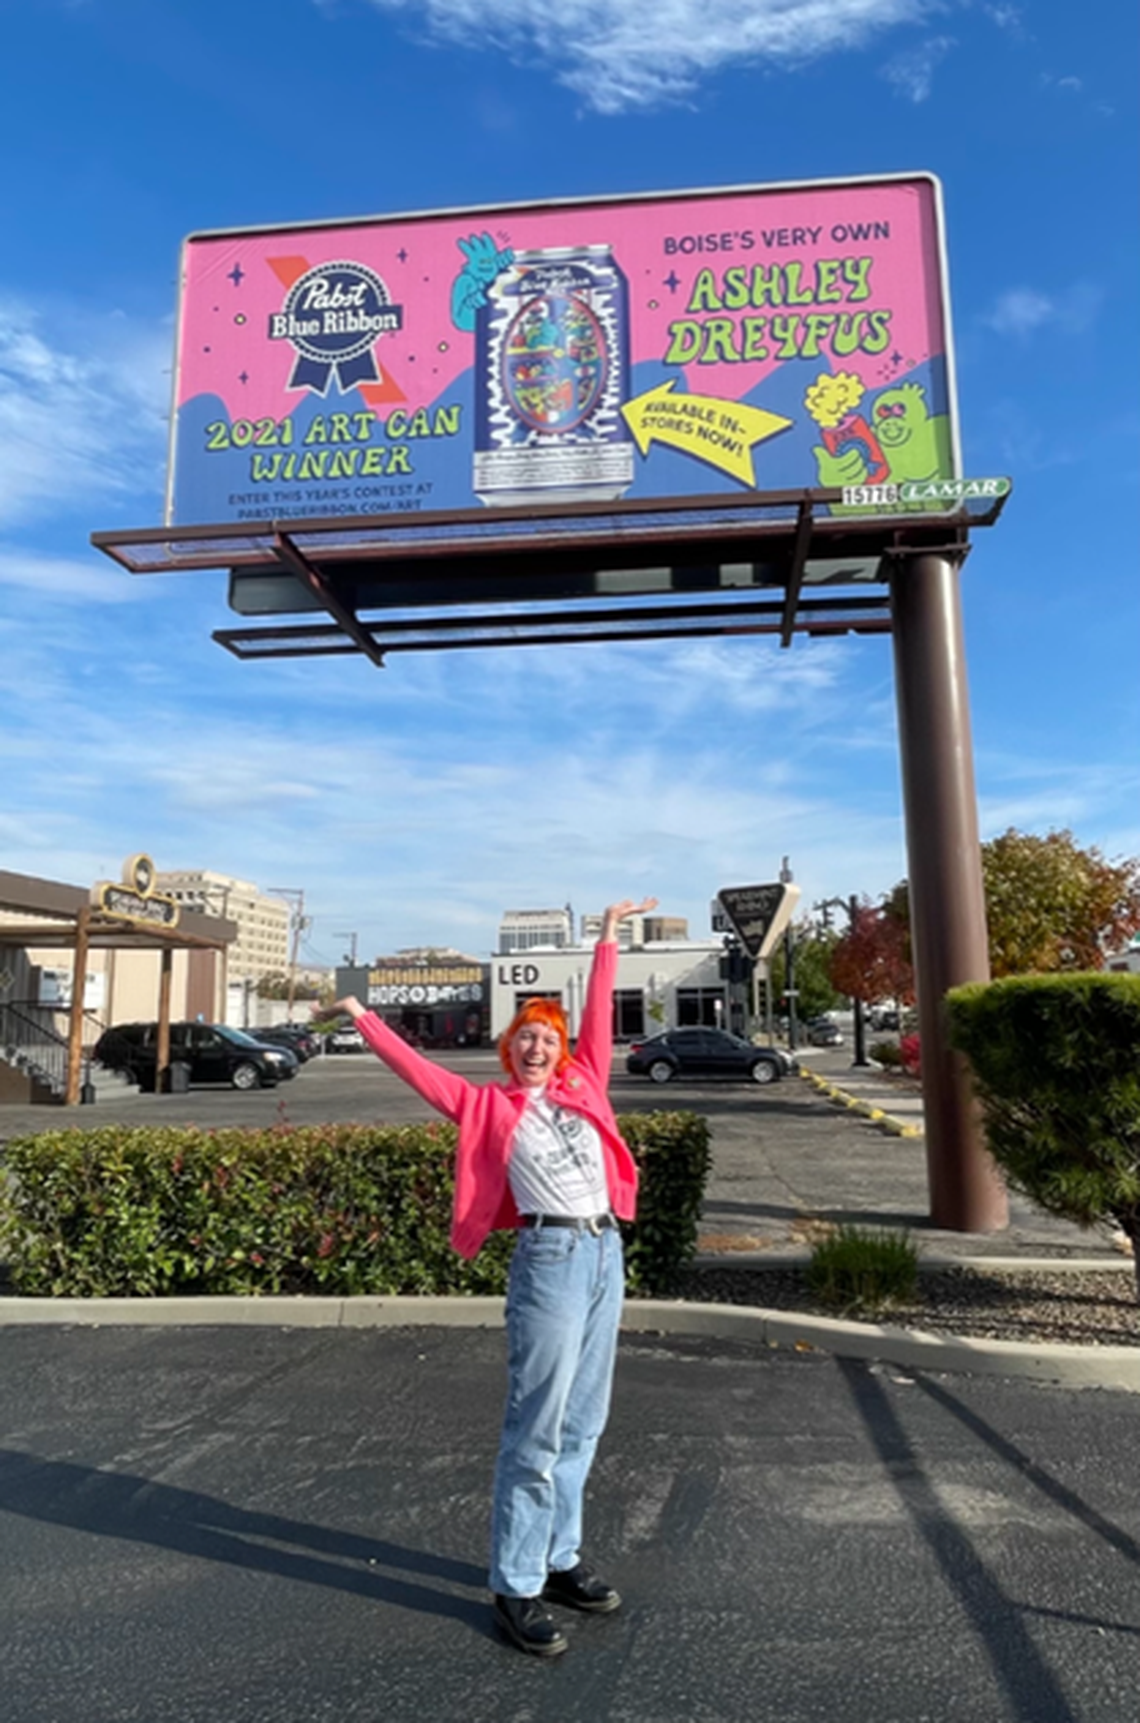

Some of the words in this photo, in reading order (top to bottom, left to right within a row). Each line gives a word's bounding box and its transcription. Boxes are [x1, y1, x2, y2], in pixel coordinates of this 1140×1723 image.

[664, 230, 755, 255] BOISE'S
[761, 226, 823, 247] VERY
[831, 222, 890, 242] OWN
[302, 278, 368, 310] Pabst
[686, 257, 873, 313] ASHLEY
[272, 313, 320, 338] Blue
[323, 310, 398, 334] Ribbon
[663, 310, 892, 366] DREYFUS
[206, 417, 293, 450] 2021
[305, 412, 376, 445] ART
[386, 405, 462, 438] CAN
[644, 402, 717, 425] AVAILABLE
[640, 417, 694, 434] STORES
[697, 425, 744, 458] NOW!
[250, 447, 413, 482] WINNER
[228, 493, 269, 505] ENTER
[272, 490, 302, 503] THIS
[305, 487, 350, 501] YEAR'S
[354, 484, 413, 498] CONTEST
[416, 482, 433, 495] AT
[845, 486, 896, 502] 15776
[909, 481, 998, 498] LAMAR
[499, 964, 539, 985] LED
